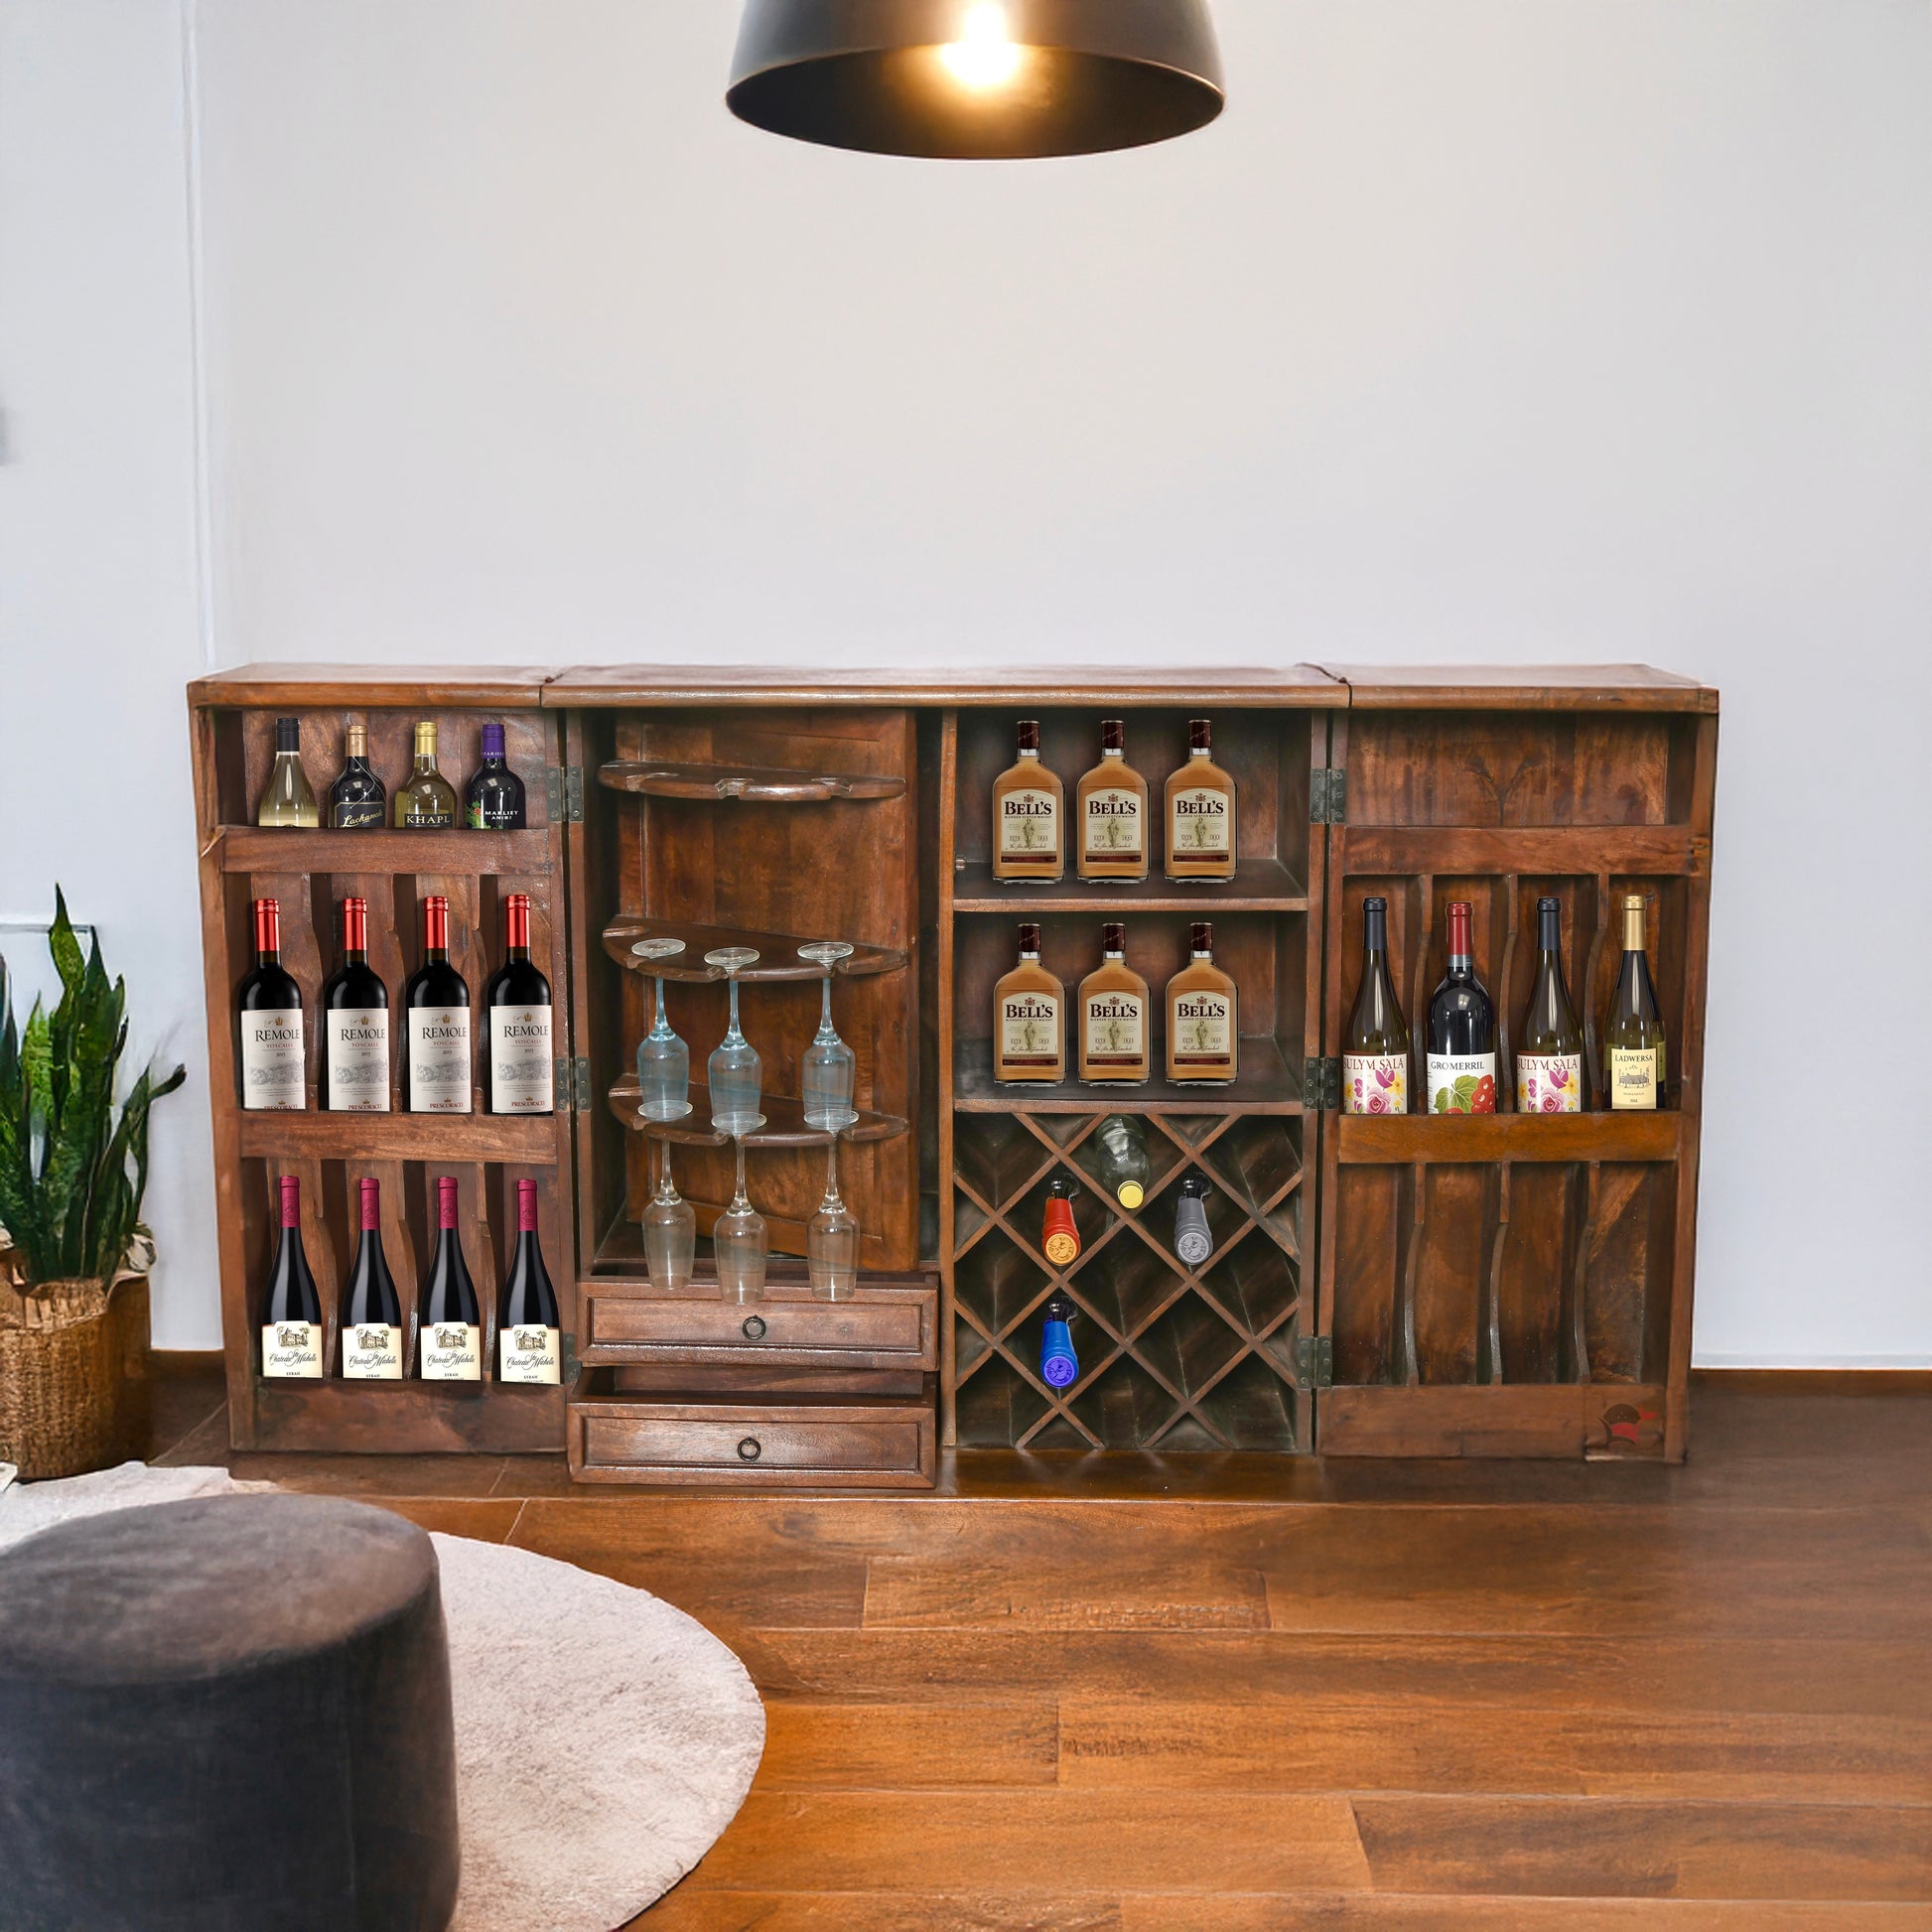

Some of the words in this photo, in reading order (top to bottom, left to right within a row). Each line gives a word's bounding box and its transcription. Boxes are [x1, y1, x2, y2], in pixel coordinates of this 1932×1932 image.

[1005, 800, 1052, 815] BELL'S
[1089, 800, 1137, 815] BELL'S
[1176, 799, 1224, 814] BELL'S
[406, 815, 450, 824] KHAPL
[1006, 1004, 1053, 1019] BELL'S
[1090, 1003, 1138, 1018] BELL'S
[1177, 1003, 1225, 1018] BELL'S
[255, 1029, 300, 1042] REMOLE
[341, 1029, 386, 1041] REMOLE
[422, 1027, 467, 1039] REMOLE
[503, 1025, 548, 1037] REMOLE
